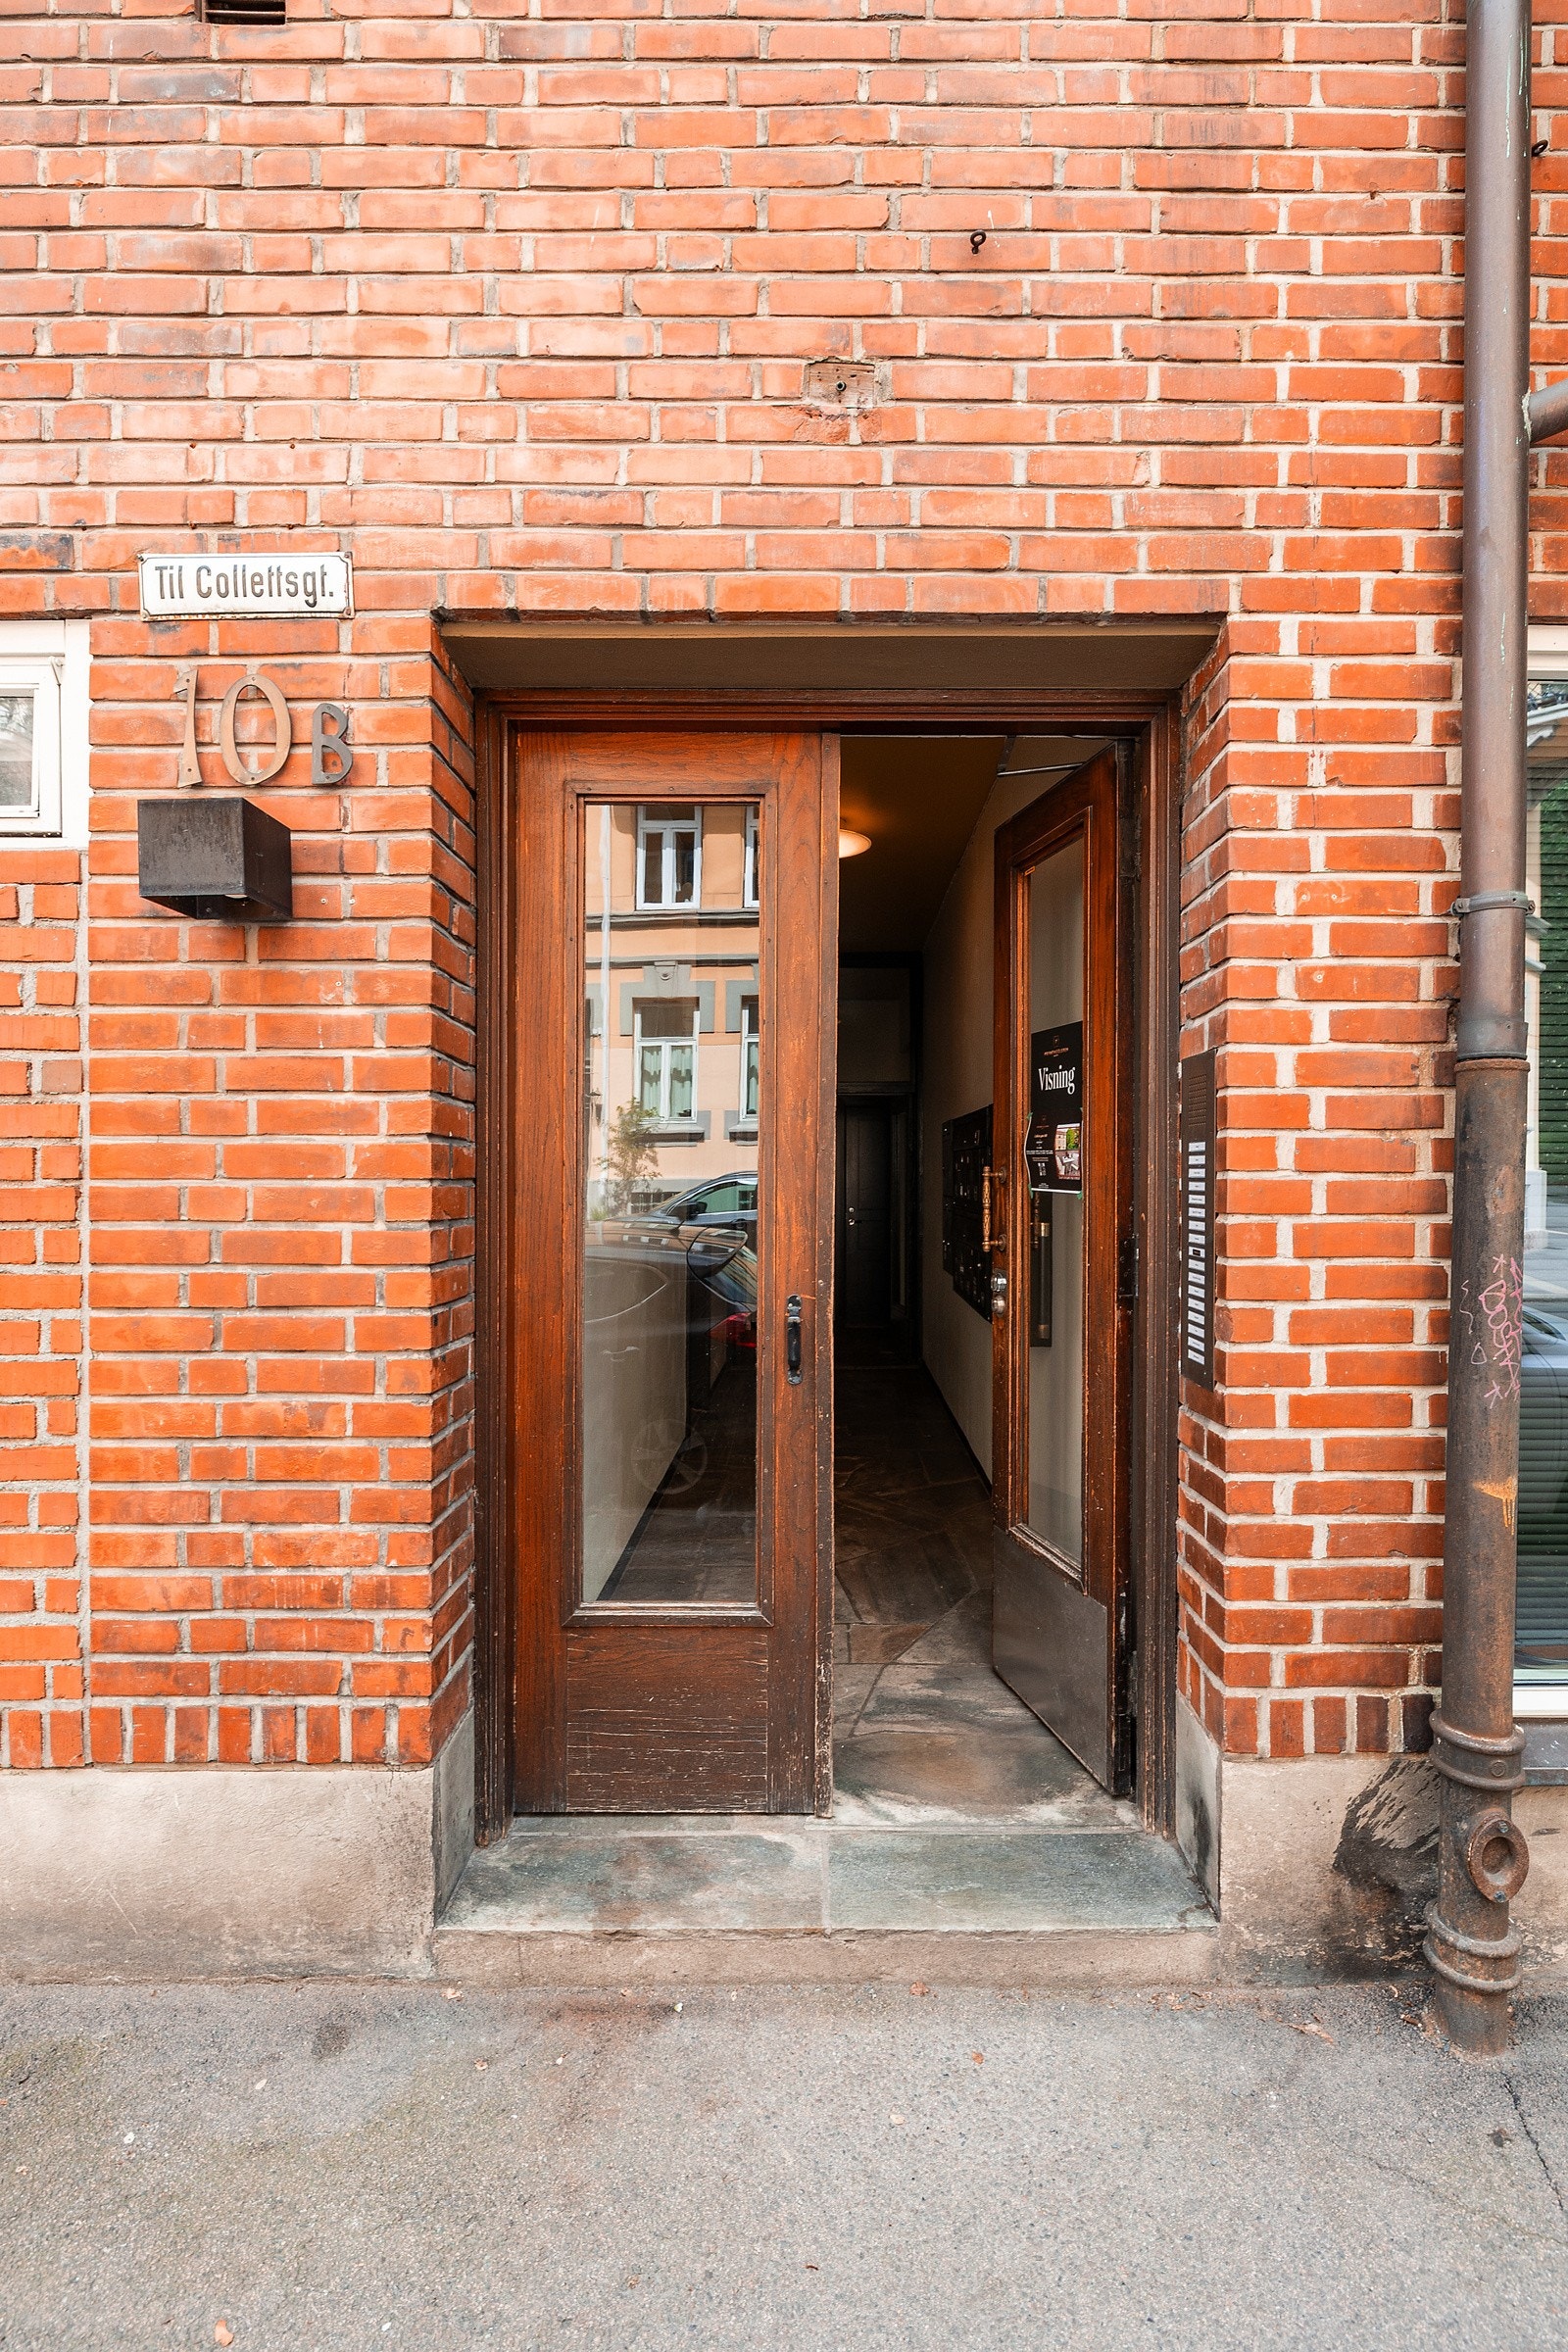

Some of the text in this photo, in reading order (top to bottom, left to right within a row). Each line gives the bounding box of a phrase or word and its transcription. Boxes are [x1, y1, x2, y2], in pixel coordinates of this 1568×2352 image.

[155, 564, 334, 608] Til Collettsgt.
[1038, 1064, 1076, 1095] Visning
